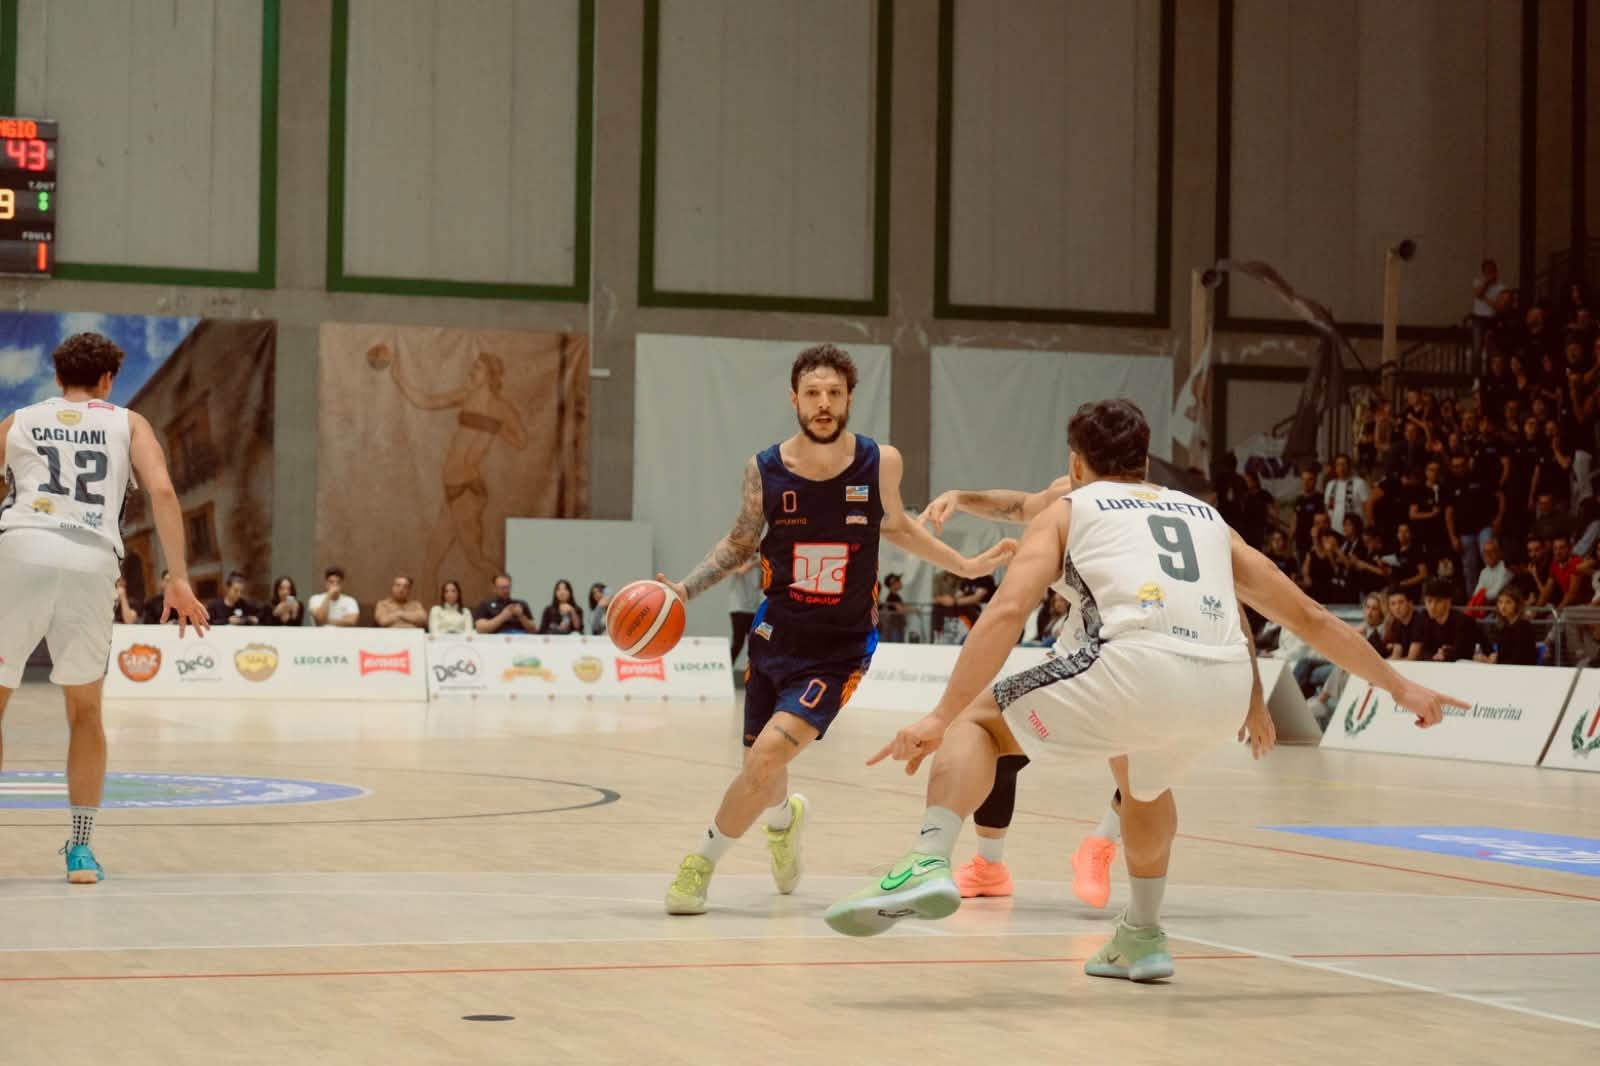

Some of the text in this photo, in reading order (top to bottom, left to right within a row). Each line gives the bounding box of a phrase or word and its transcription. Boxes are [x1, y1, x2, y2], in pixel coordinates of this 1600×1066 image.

[6, 139, 48, 171] 43
[37, 242, 47, 271] 1
[31, 426, 107, 445] CAGLIANI
[36, 445, 108, 506] 12
[782, 490, 797, 513] 0
[1095, 498, 1214, 521] LORENZETTI
[1146, 514, 1200, 583] 9
[293, 655, 349, 665] LEOCATA
[1472, 703, 1523, 721] Armerina
